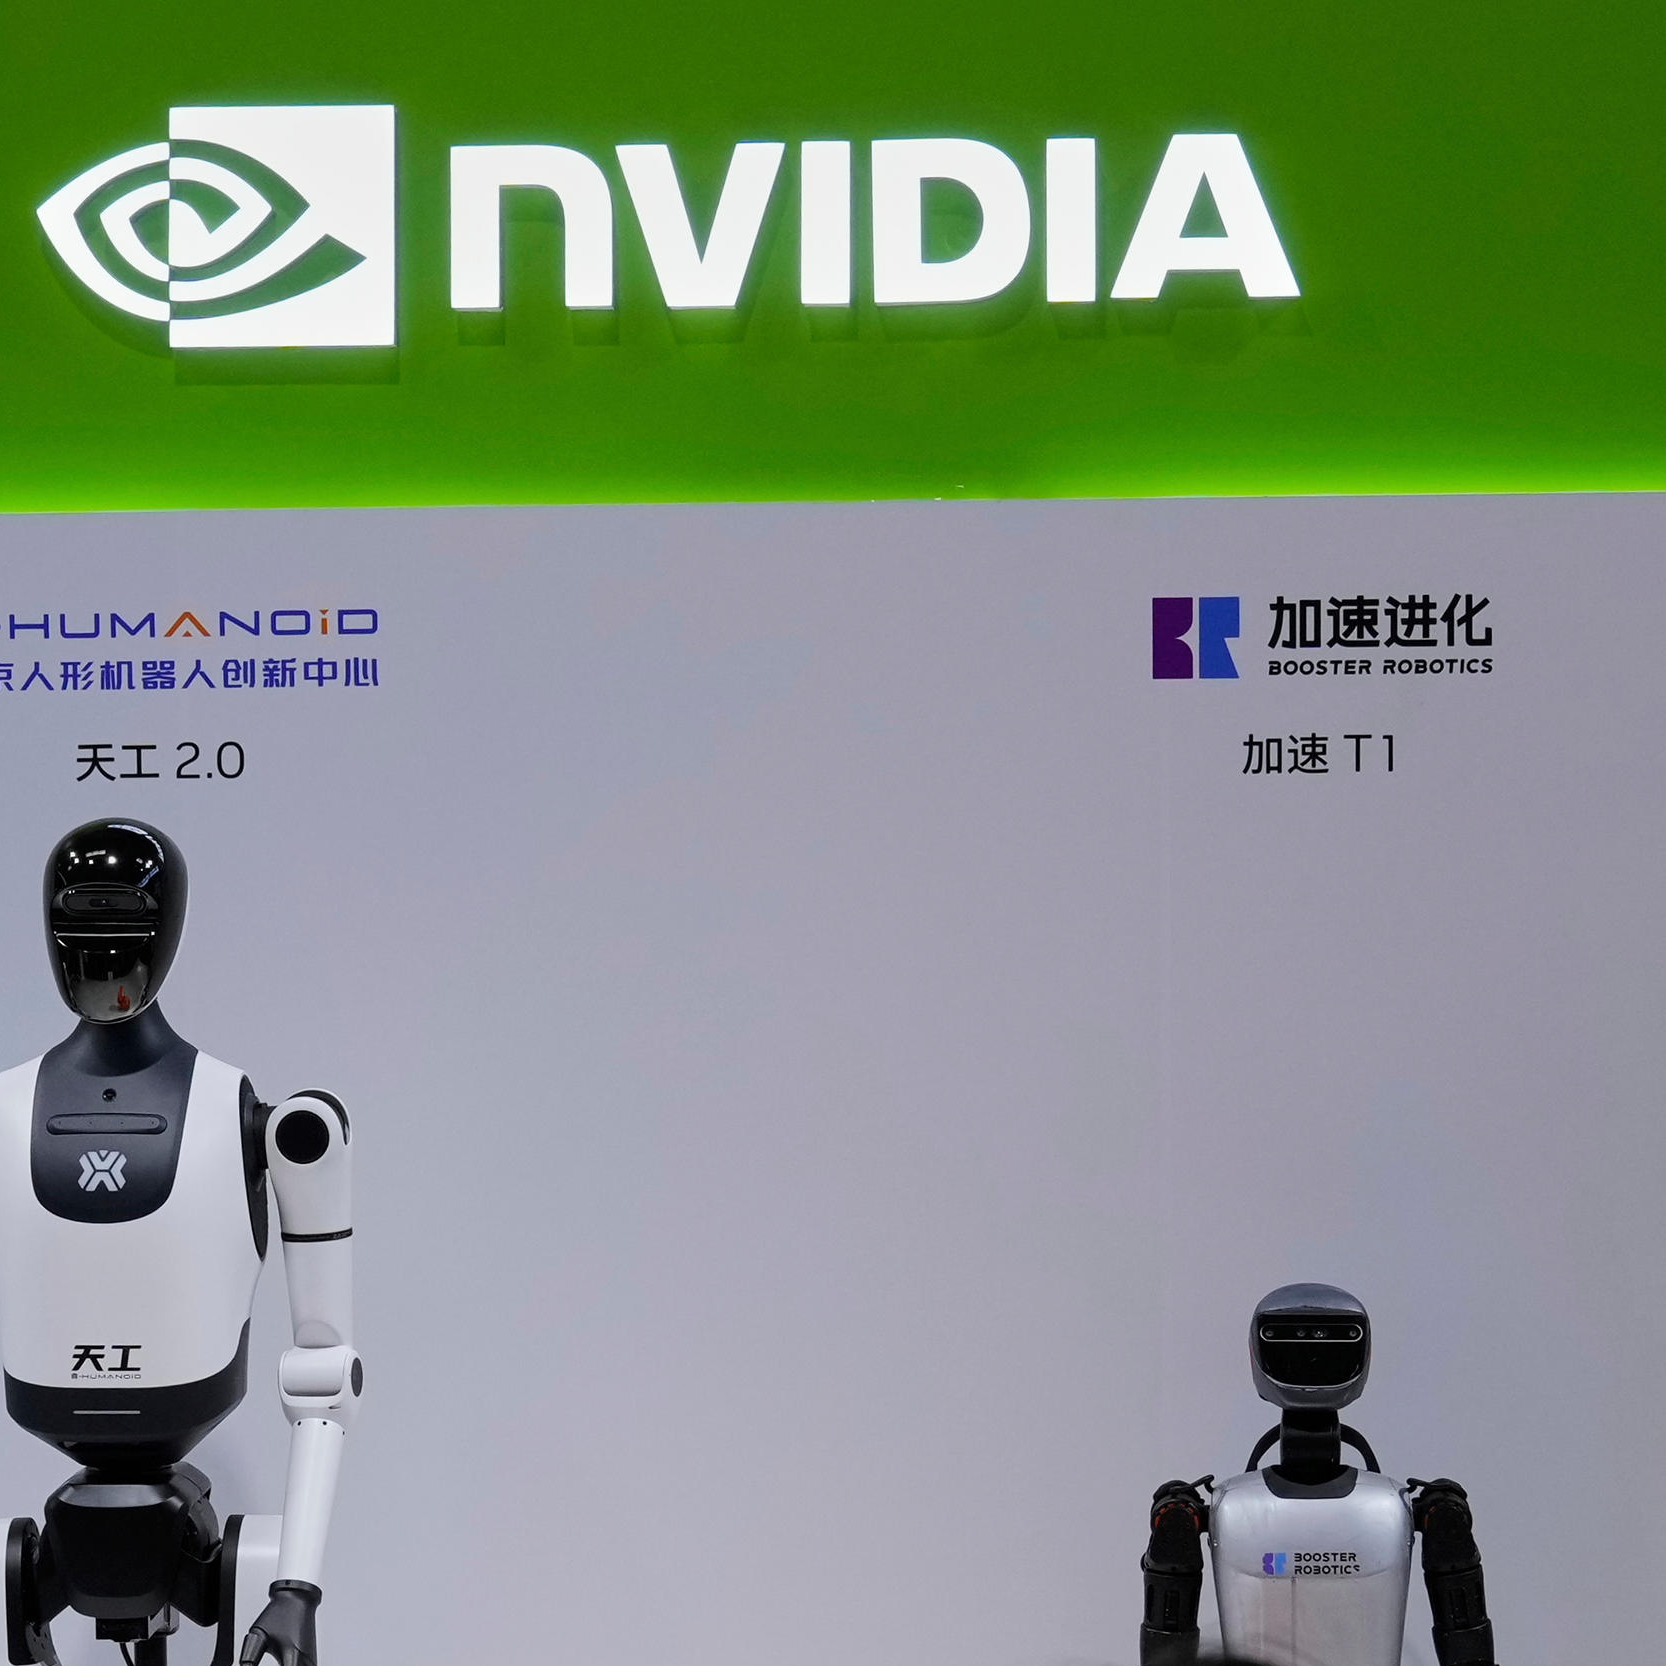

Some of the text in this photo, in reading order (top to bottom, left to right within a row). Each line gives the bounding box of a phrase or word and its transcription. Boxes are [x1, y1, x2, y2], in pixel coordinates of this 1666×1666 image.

[1267, 593, 1493, 649] 加速进化
[1268, 657, 1494, 676] BOOSTER ROBOTICS
[75, 741, 245, 782] 天工 2.0
[1242, 733, 1396, 775] 加速 T1
[71, 1344, 142, 1372] 天工
[1294, 1552, 1357, 1562] BOOSTER
[1294, 1565, 1361, 1575] ROBOTICS
